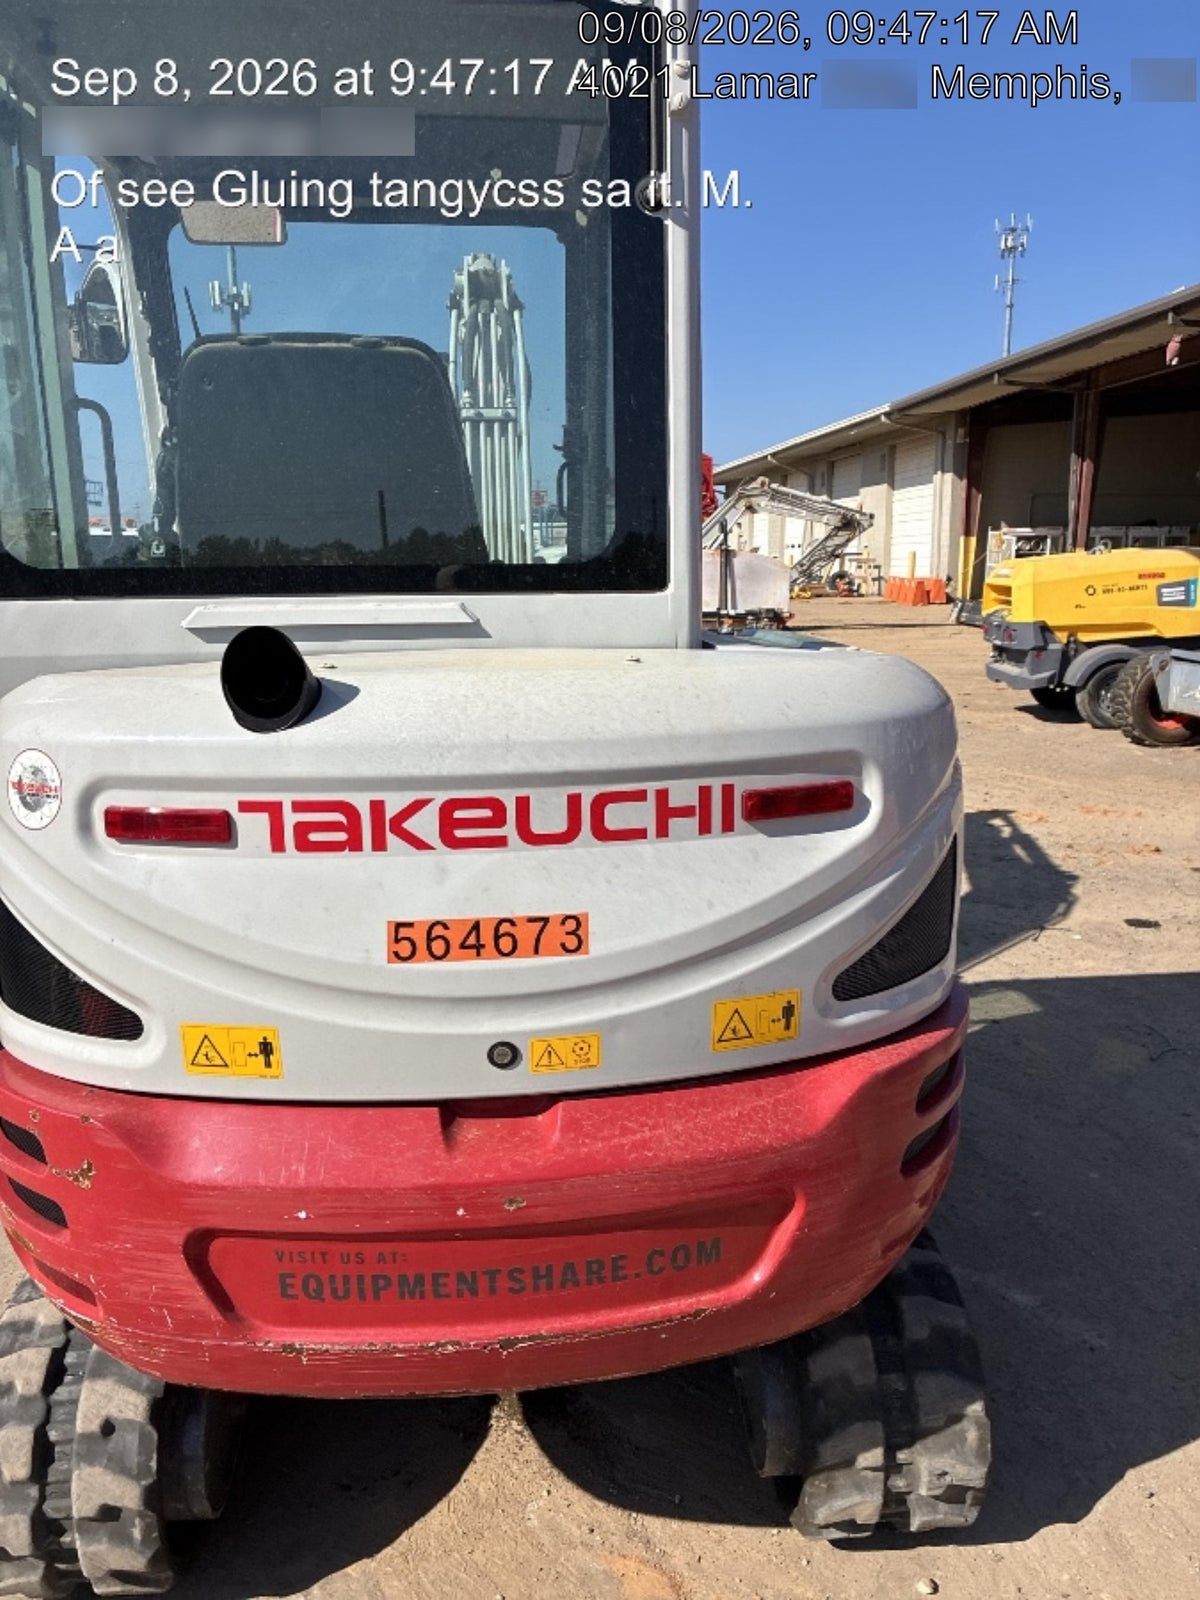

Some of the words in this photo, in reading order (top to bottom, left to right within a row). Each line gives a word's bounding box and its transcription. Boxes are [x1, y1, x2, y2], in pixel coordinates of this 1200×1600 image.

[392, 914, 584, 962] 564673
[274, 1249, 329, 1265] VISIT
[339, 1250, 366, 1266] US
[376, 1250, 407, 1265] AT:
[278, 1237, 722, 1302] EQUIPMENTSHARE.COM
